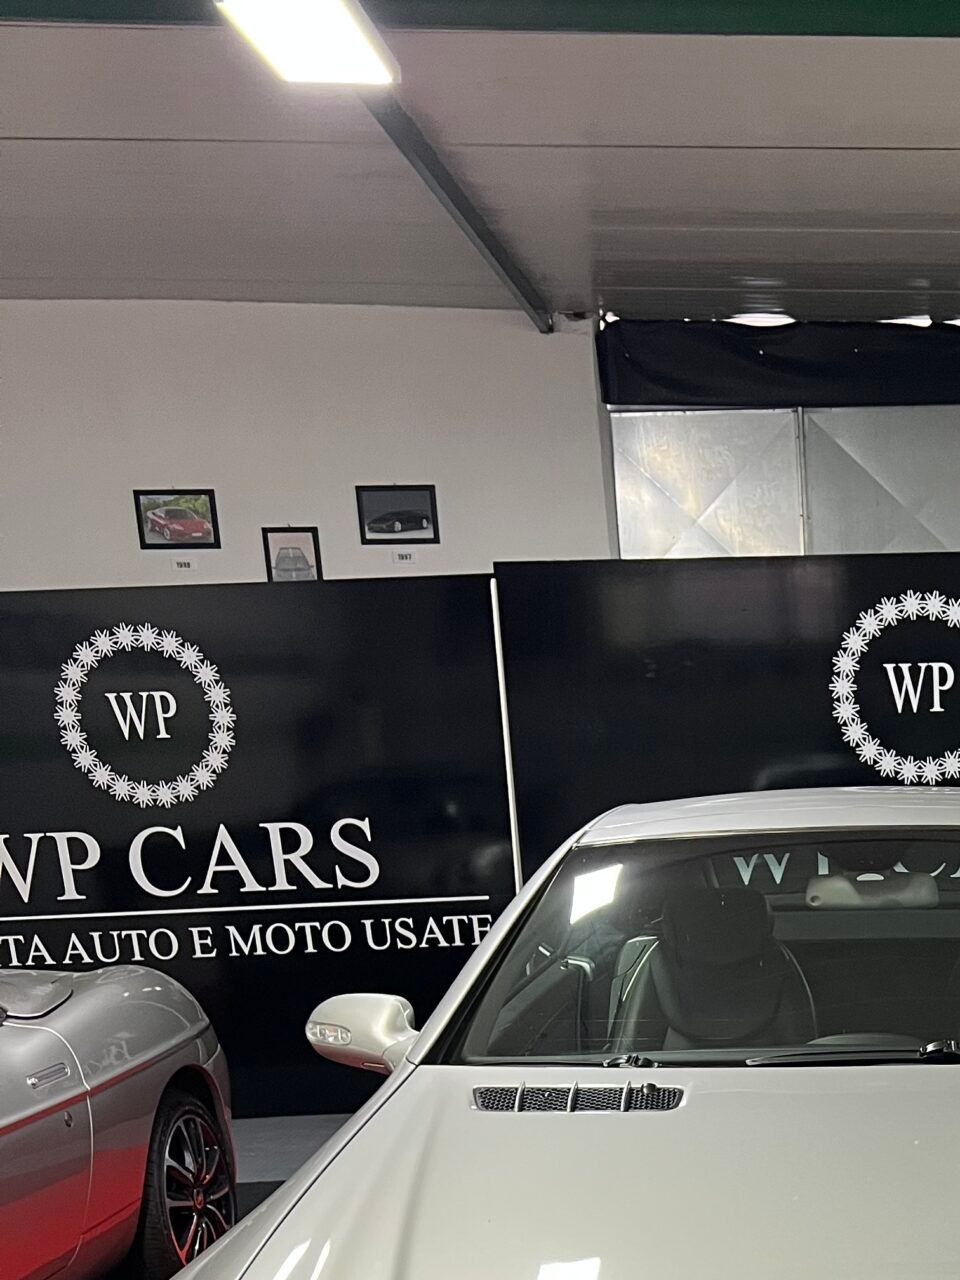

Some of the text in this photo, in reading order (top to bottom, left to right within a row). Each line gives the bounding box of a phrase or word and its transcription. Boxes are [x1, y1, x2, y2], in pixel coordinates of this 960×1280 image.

[882, 662, 955, 713] WP
[104, 691, 177, 741] WP
[128, 817, 380, 897] CARS
[62, 928, 179, 964] AUTO
[188, 926, 217, 958] E
[224, 920, 352, 956] MOTO
